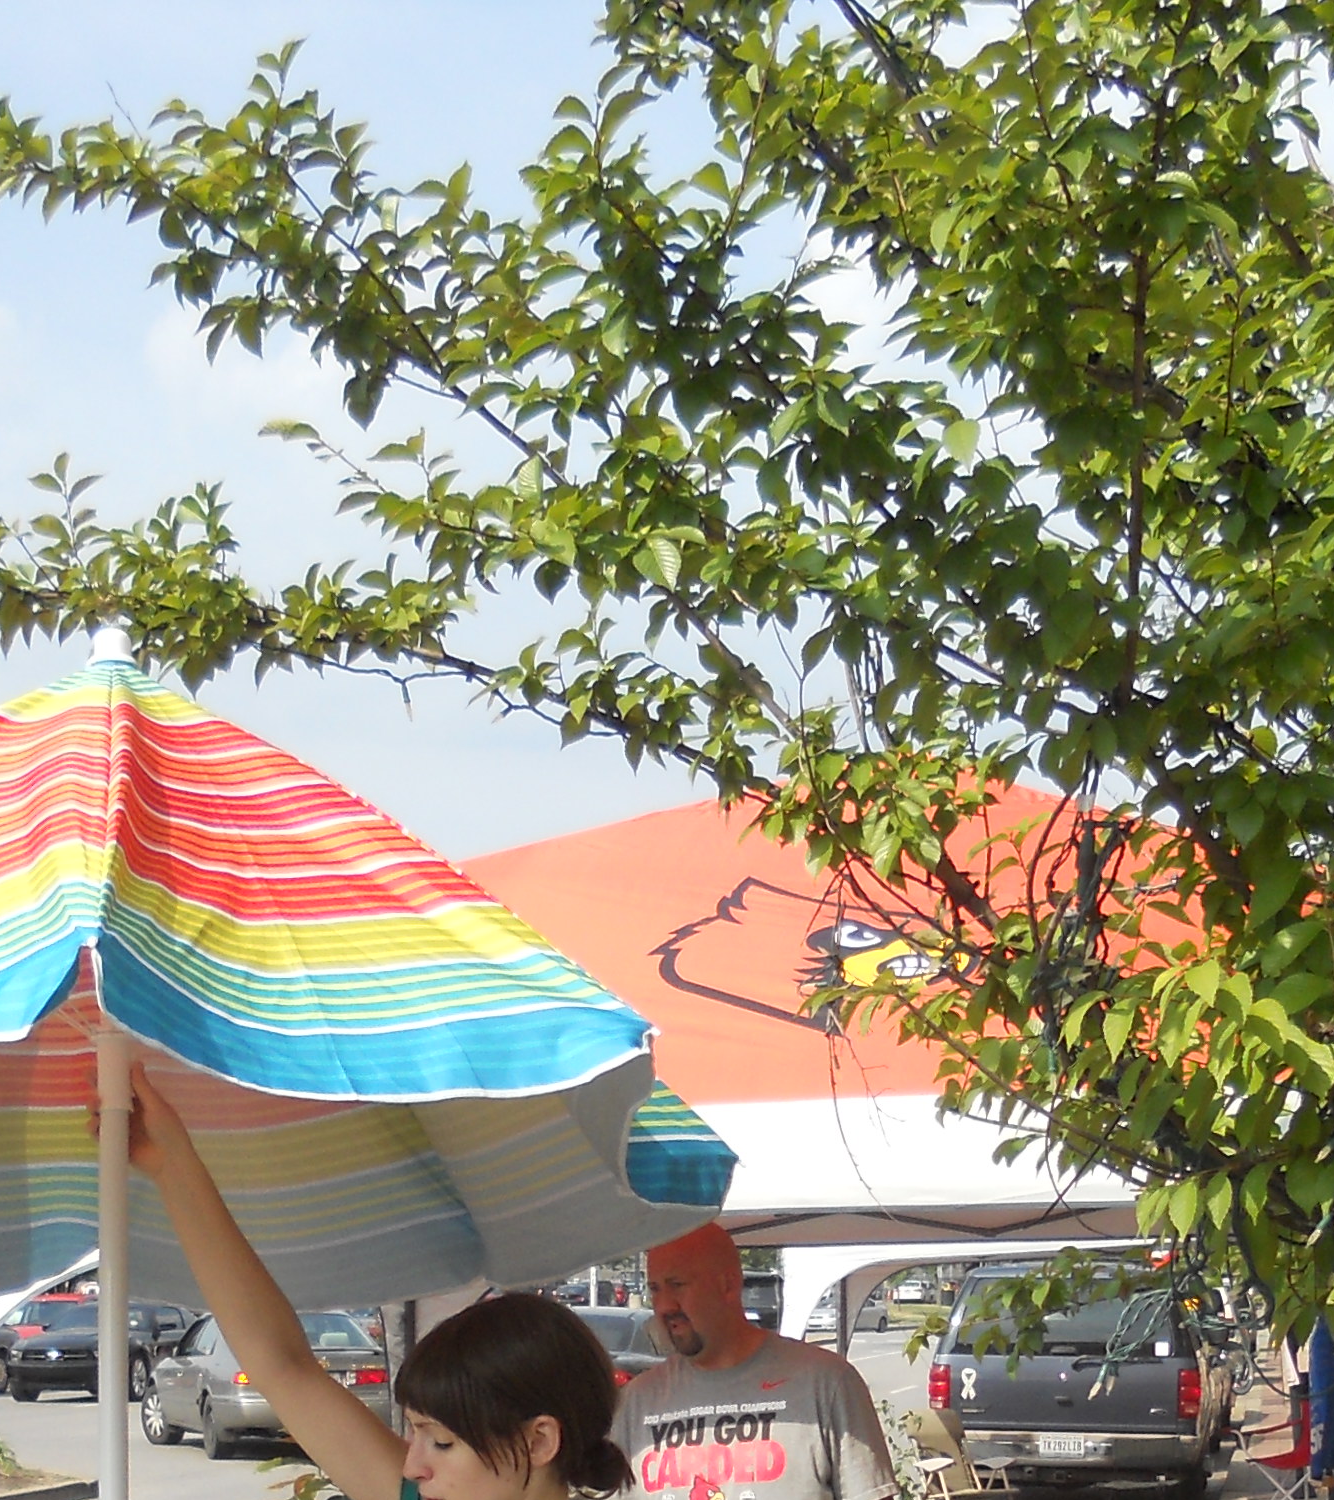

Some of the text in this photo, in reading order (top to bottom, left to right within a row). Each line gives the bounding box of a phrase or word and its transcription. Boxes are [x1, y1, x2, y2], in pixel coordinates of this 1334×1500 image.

[689, 1406, 715, 1417] SUGAR
[715, 1404, 739, 1414] BOWL
[740, 1400, 787, 1412] CHAMPIONS
[652, 1412, 776, 1452] YOU GOT
[641, 1440, 787, 1494] CARDED
